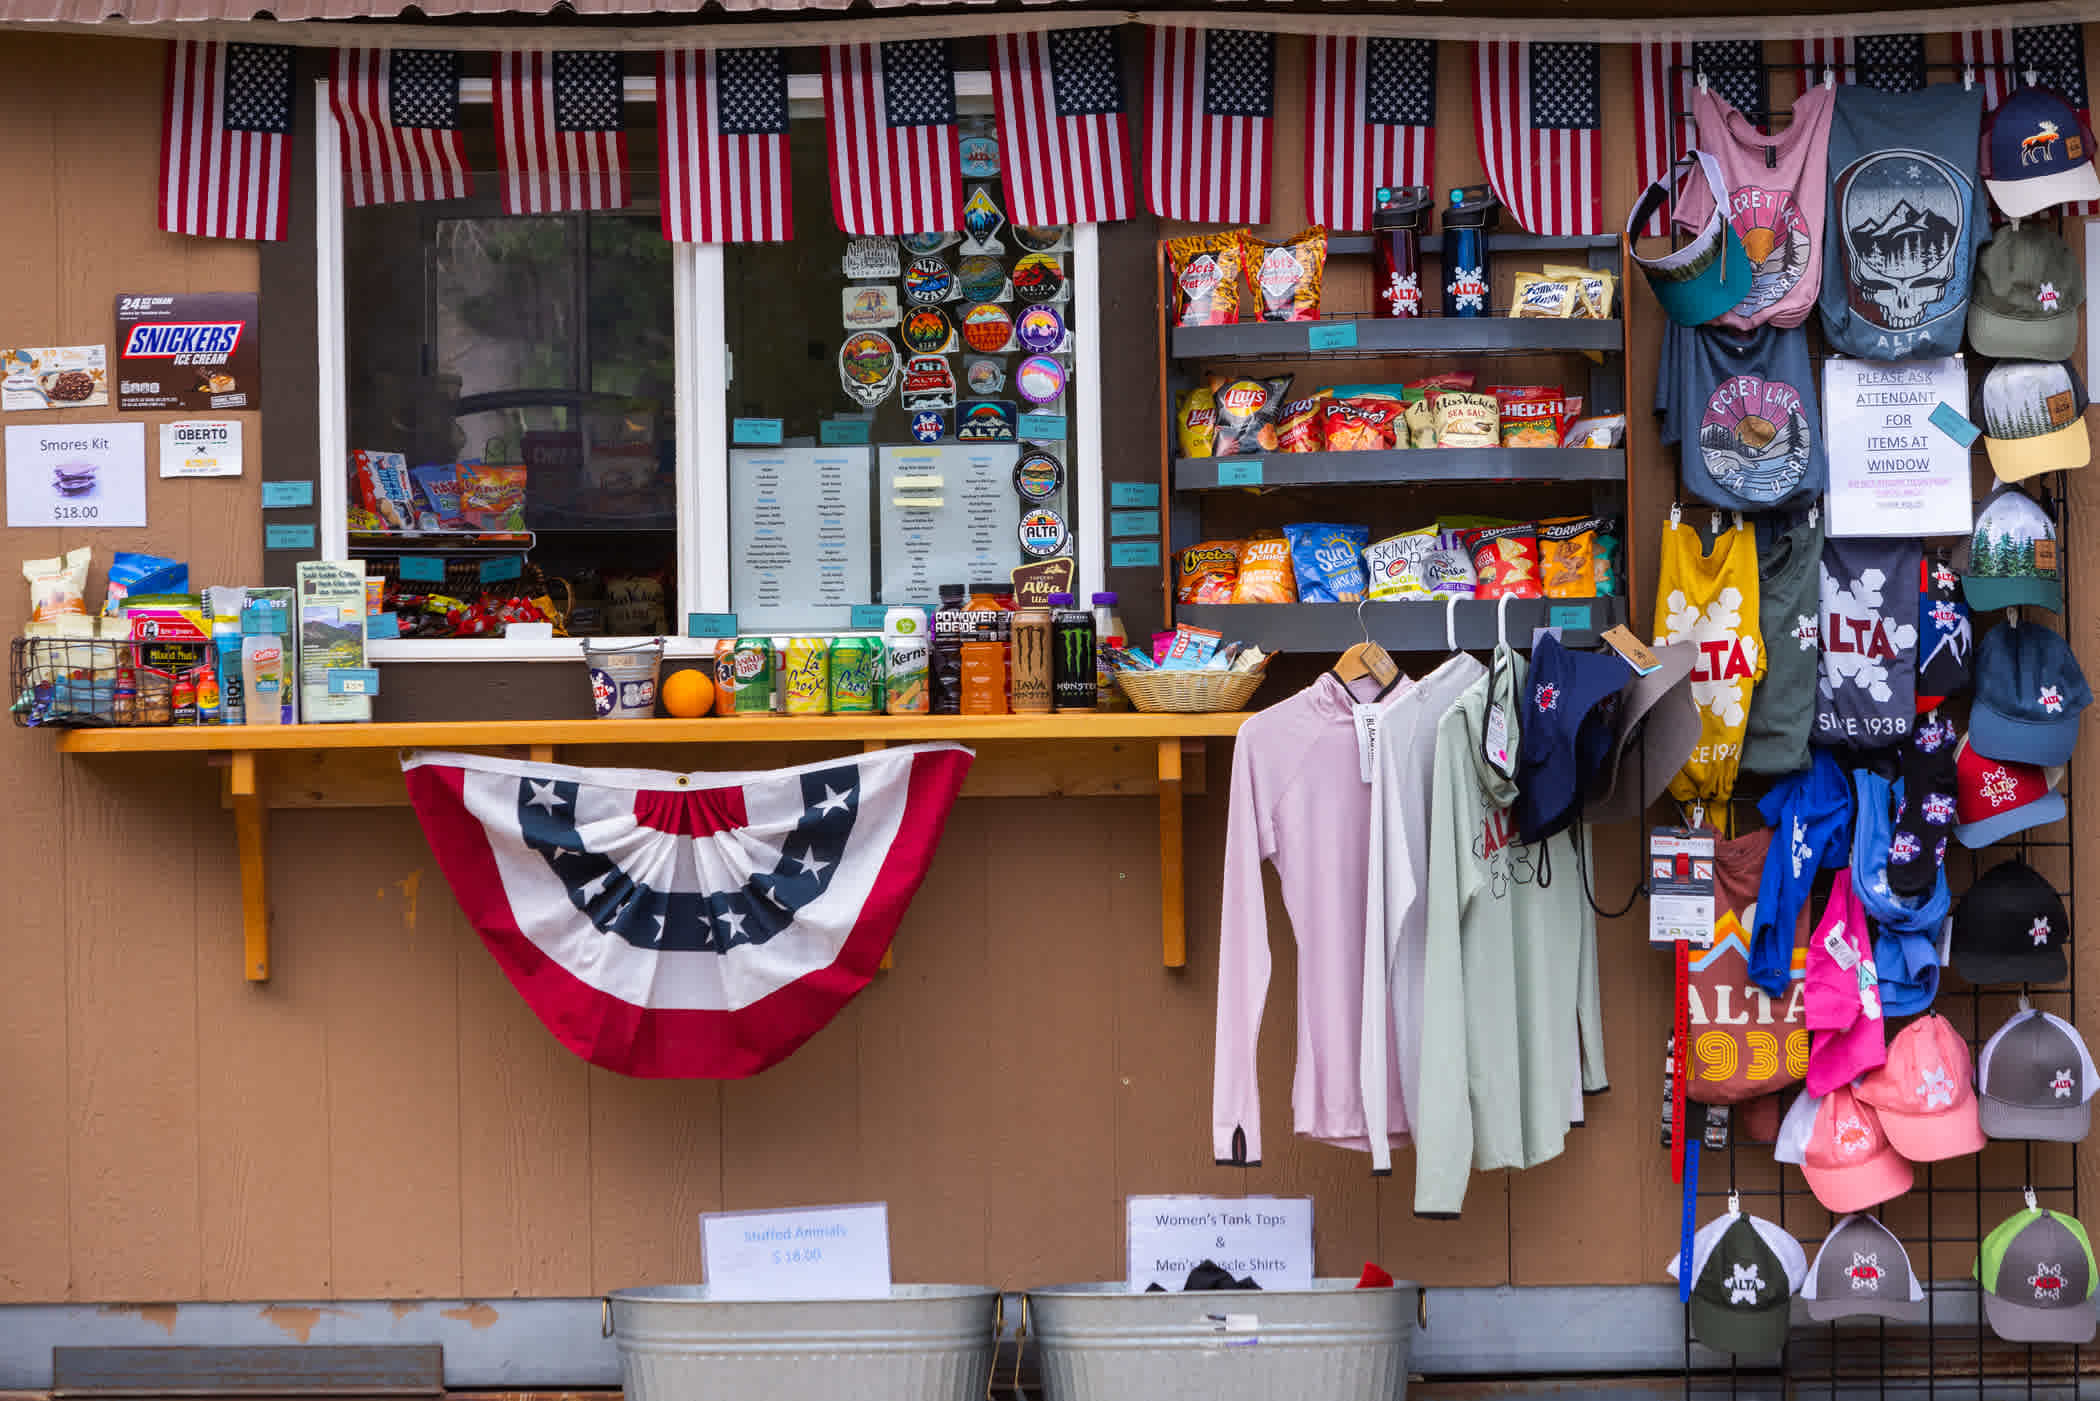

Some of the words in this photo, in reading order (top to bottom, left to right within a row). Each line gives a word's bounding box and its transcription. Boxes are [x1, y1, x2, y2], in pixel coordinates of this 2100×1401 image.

[1389, 289, 1420, 301] ALTA
[1453, 283, 1486, 296] ALTA
[2040, 292, 2058, 301] ALTA
[120, 298, 140, 310] 24
[130, 327, 238, 353] SNICKERS
[1877, 329, 1932, 349] ALTA
[174, 353, 193, 366] ICE
[192, 352, 228, 365] CREAM
[910, 376, 944, 386] ALTA
[1857, 371, 1907, 385] PLEASE
[1908, 370, 1934, 383] ASK
[1225, 389, 1266, 410] Lay's
[1856, 391, 1937, 405] ATTENDANT
[1885, 414, 1912, 426] FOR
[917, 422, 943, 433] ALTA
[959, 427, 1014, 438] ALTA
[178, 428, 228, 441] OBERTO
[40, 438, 88, 452] Smores
[91, 438, 110, 451] Kit
[1867, 437, 1909, 449] ITEMS
[1911, 436, 1929, 448] AT
[1867, 458, 1930, 472] WINDOW
[54, 506, 98, 520] $18.00
[1026, 525, 1058, 538] ALTA
[1244, 542, 1286, 565] Sun
[1373, 538, 1424, 560] SKINNY
[1314, 546, 1353, 573] Sun
[1936, 572, 1956, 582] ALTA
[1021, 580, 1064, 594] Alta
[1933, 610, 1956, 622] ALTA
[801, 650, 821, 674] La
[2043, 696, 2060, 705] ALTA
[1864, 716, 1906, 736] 1938
[1927, 805, 1950, 815] ALTA
[2032, 927, 2049, 937] ALTA
[2054, 1080, 2072, 1089] ALTA
[1155, 1213, 1217, 1227] Women's
[1221, 1213, 1252, 1226] Tank
[1255, 1213, 1287, 1228] Tops
[1215, 1236, 1226, 1249] &
[1249, 1258, 1287, 1272] Shirts
[1851, 1266, 1880, 1280] ALTA
[1729, 1279, 1760, 1291] ALTA
[2034, 1276, 2061, 1290] ALTA
